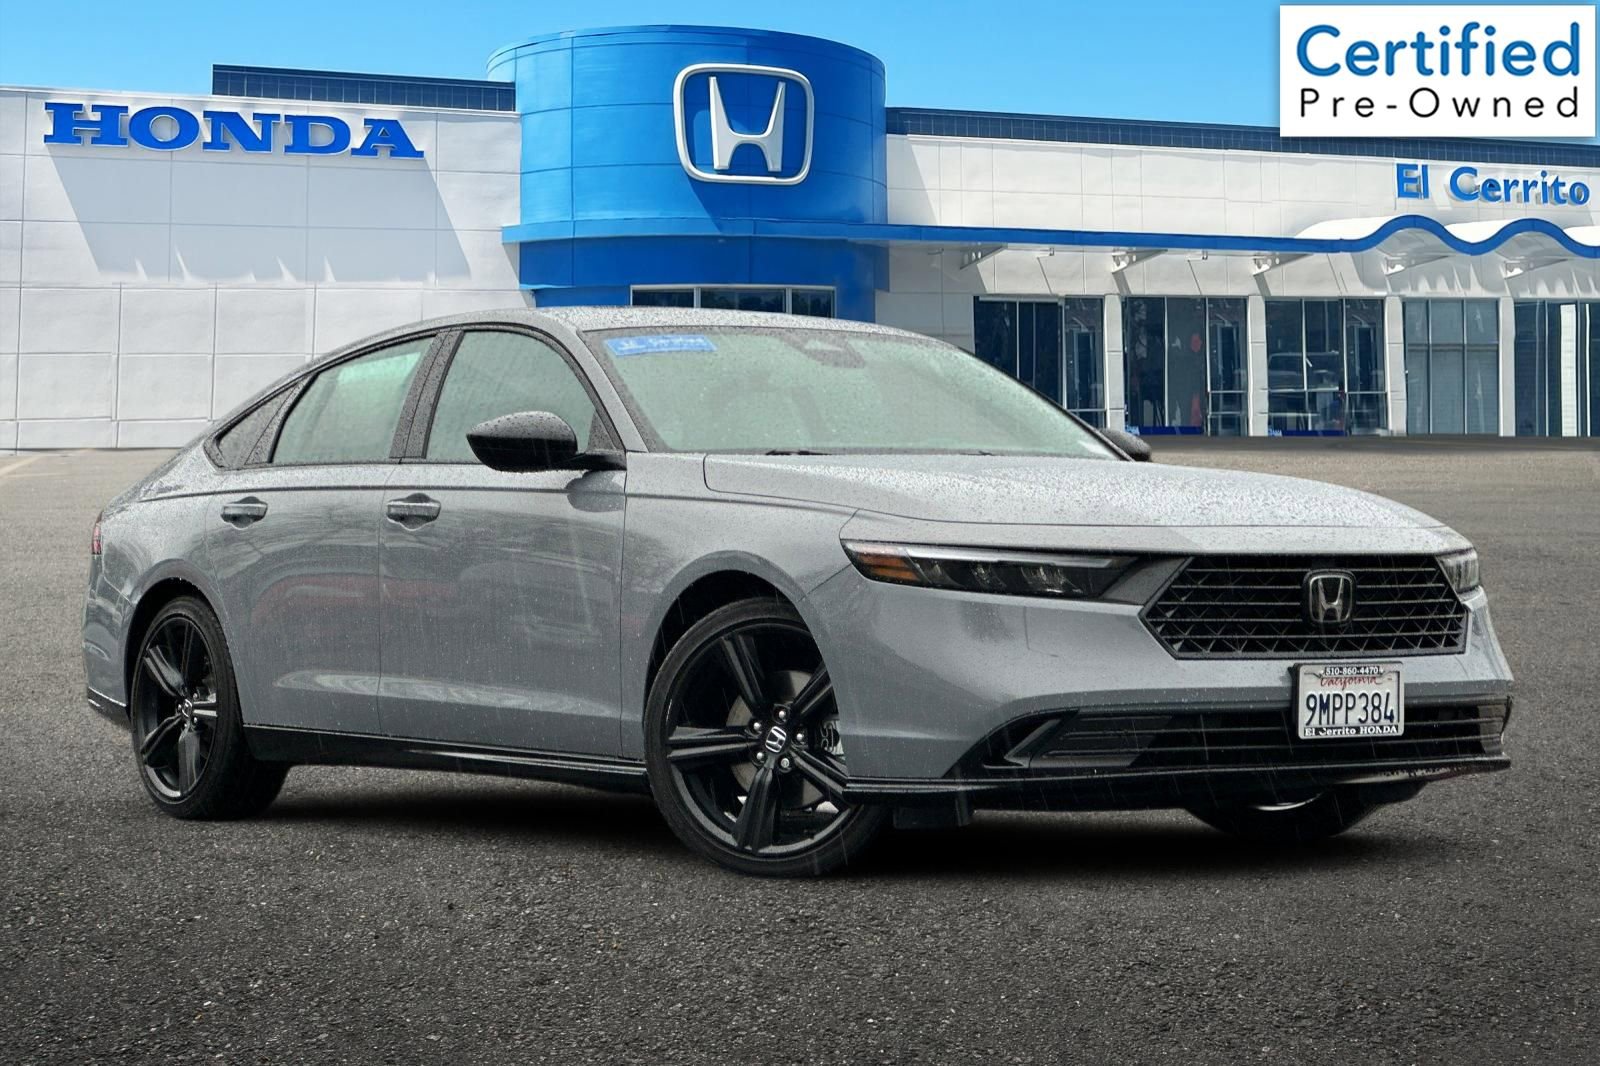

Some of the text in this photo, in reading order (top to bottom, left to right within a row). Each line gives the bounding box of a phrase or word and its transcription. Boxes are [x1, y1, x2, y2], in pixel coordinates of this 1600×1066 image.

[44, 101, 424, 158] HONDA
[1396, 163, 1590, 205] El Cerrito
[1306, 693, 1394, 725] 9MPP384
[1319, 727, 1356, 735] Cerrito
[1360, 726, 1397, 734] HONDA
